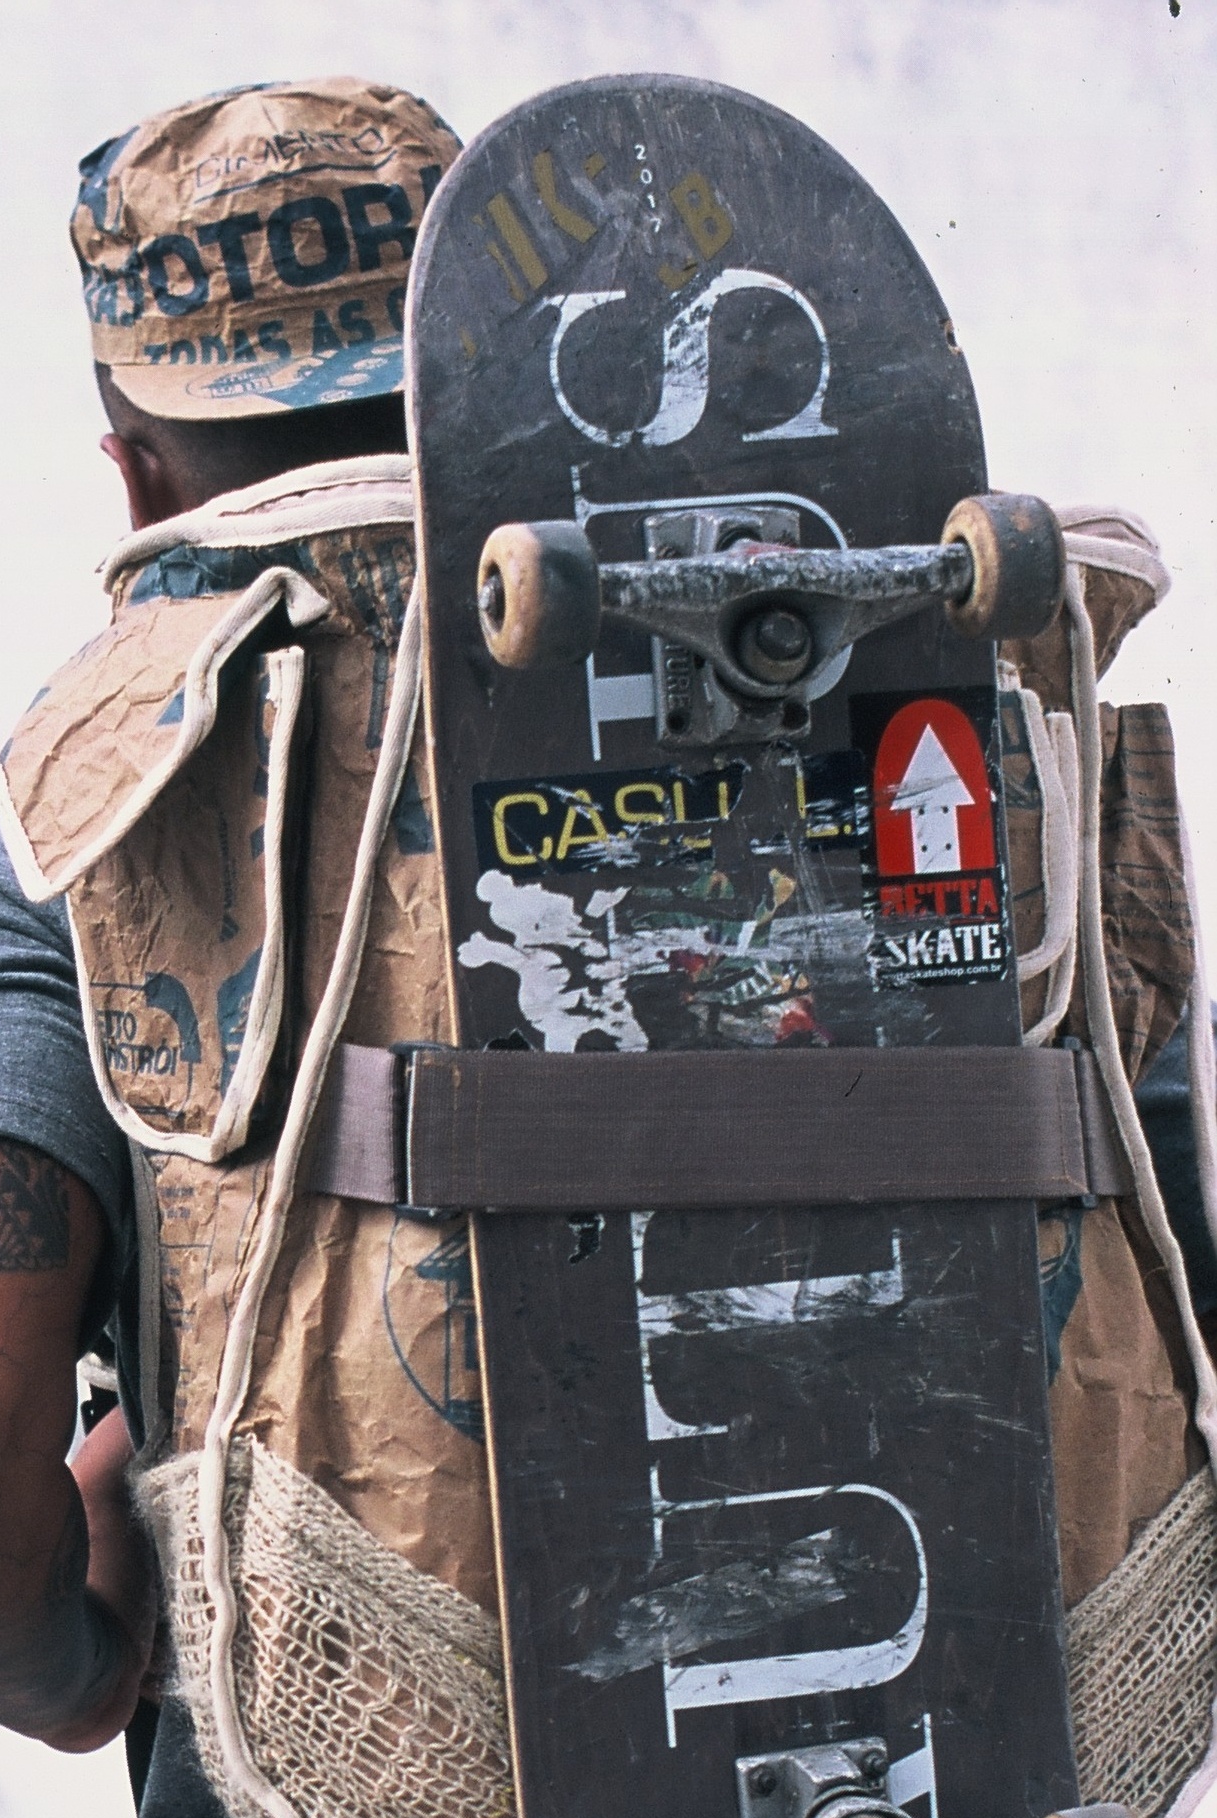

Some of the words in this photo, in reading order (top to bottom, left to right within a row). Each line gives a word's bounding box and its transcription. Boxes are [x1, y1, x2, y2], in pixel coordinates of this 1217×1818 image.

[92, 165, 442, 324] OTOR
[313, 299, 376, 355] AS
[884, 923, 1002, 967] SKATE
